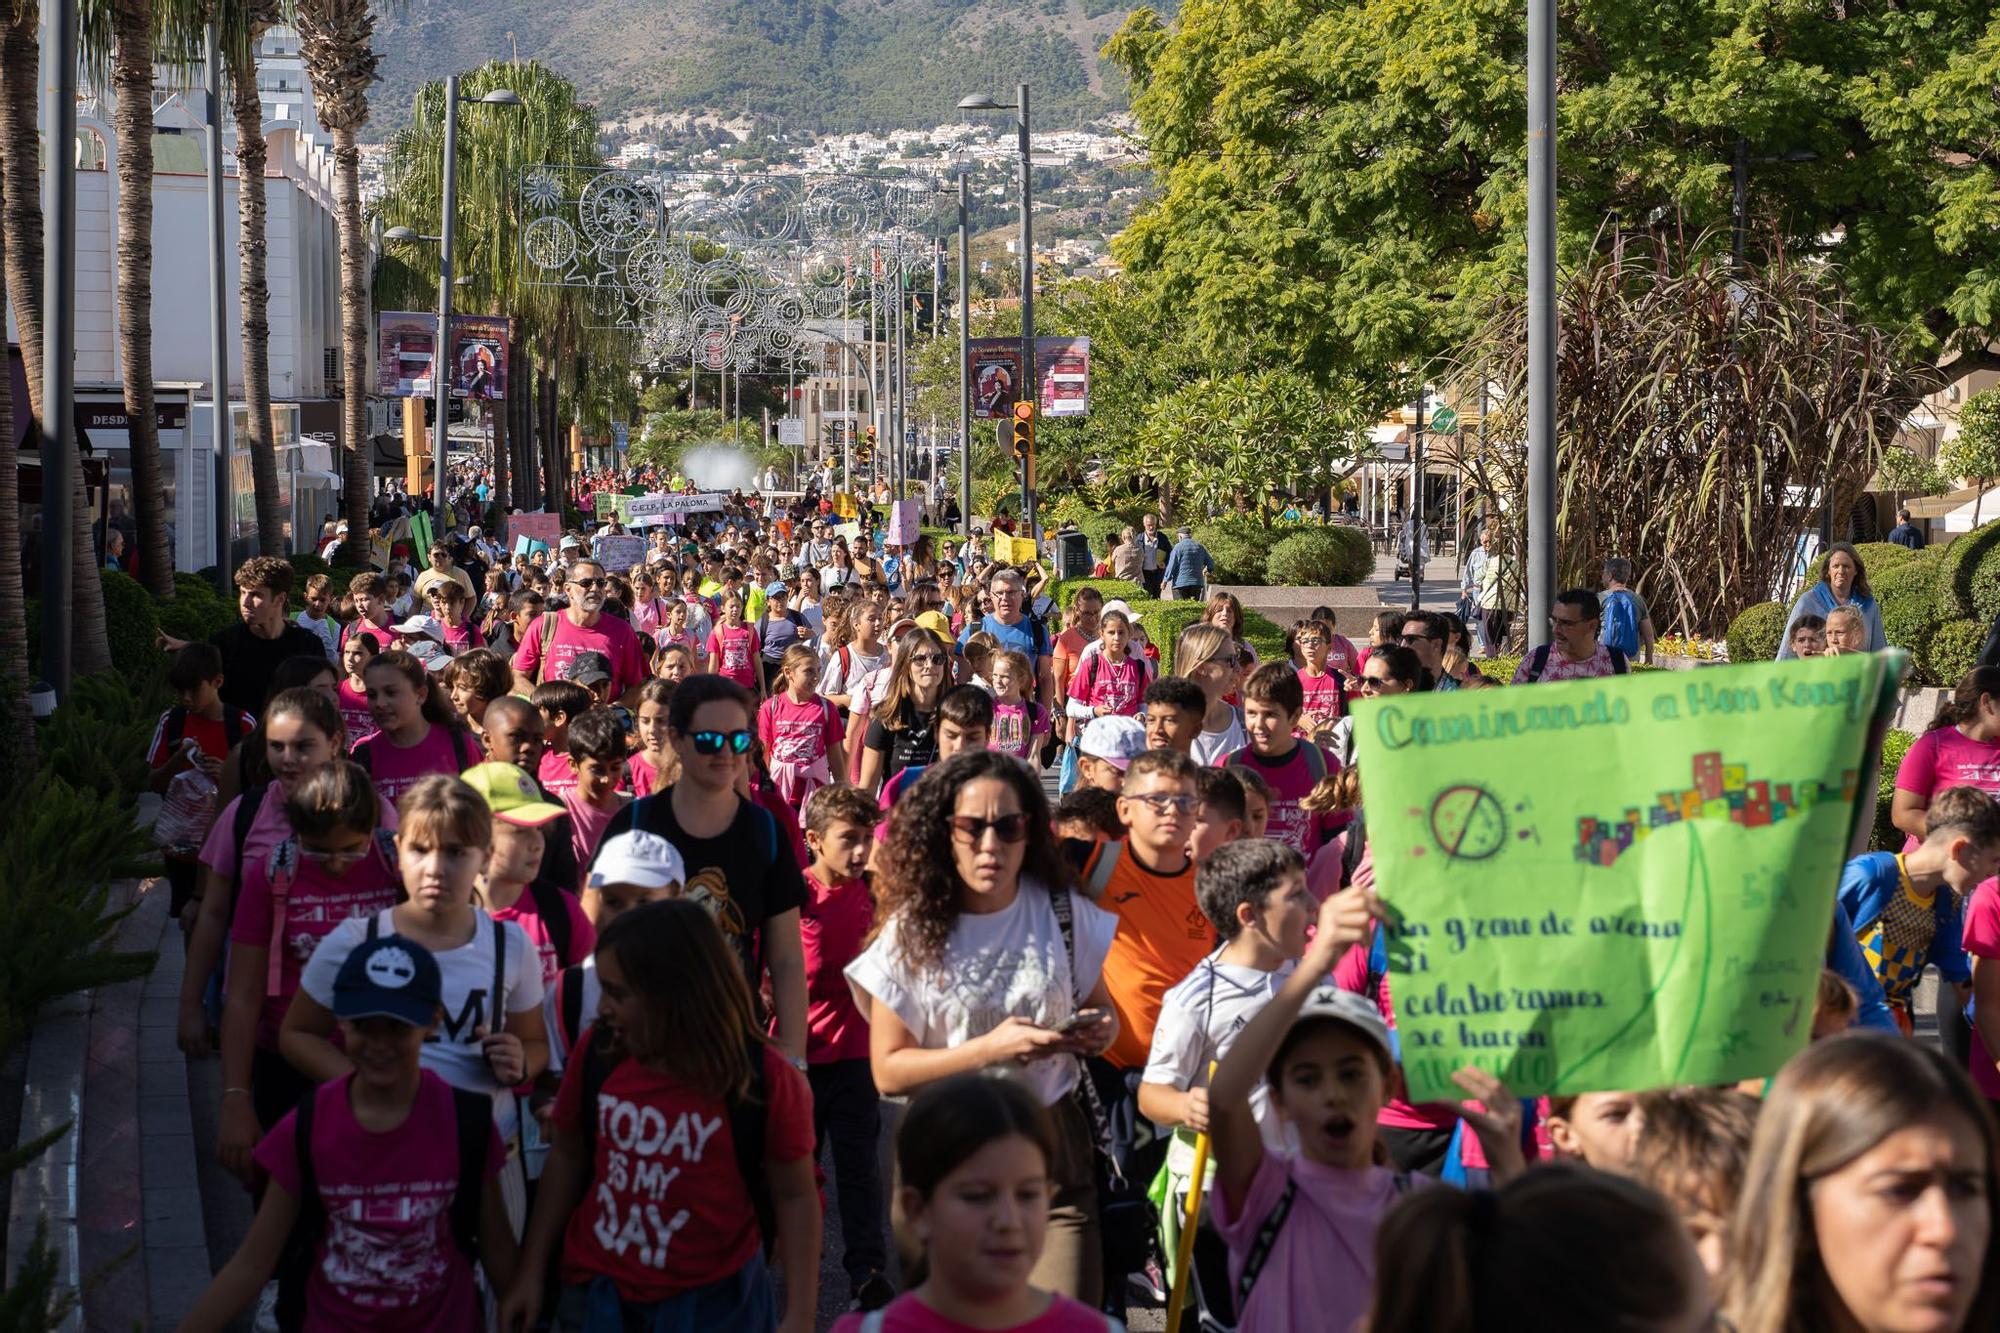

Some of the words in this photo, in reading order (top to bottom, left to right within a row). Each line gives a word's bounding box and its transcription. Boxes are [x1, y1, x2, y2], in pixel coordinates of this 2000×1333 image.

[662, 501, 673, 509] LA
[675, 499, 709, 508] PALOMA
[1376, 688, 1629, 750] Caminando
[1651, 693, 1679, 721] a
[1769, 676, 1861, 724] Kong
[1540, 910, 1575, 937] de
[1589, 914, 1683, 938] arena
[1459, 1020, 1547, 1048] hacen
[597, 1092, 723, 1163] TODAY
[632, 1158, 681, 1201] MY
[594, 1183, 691, 1270] DAY
